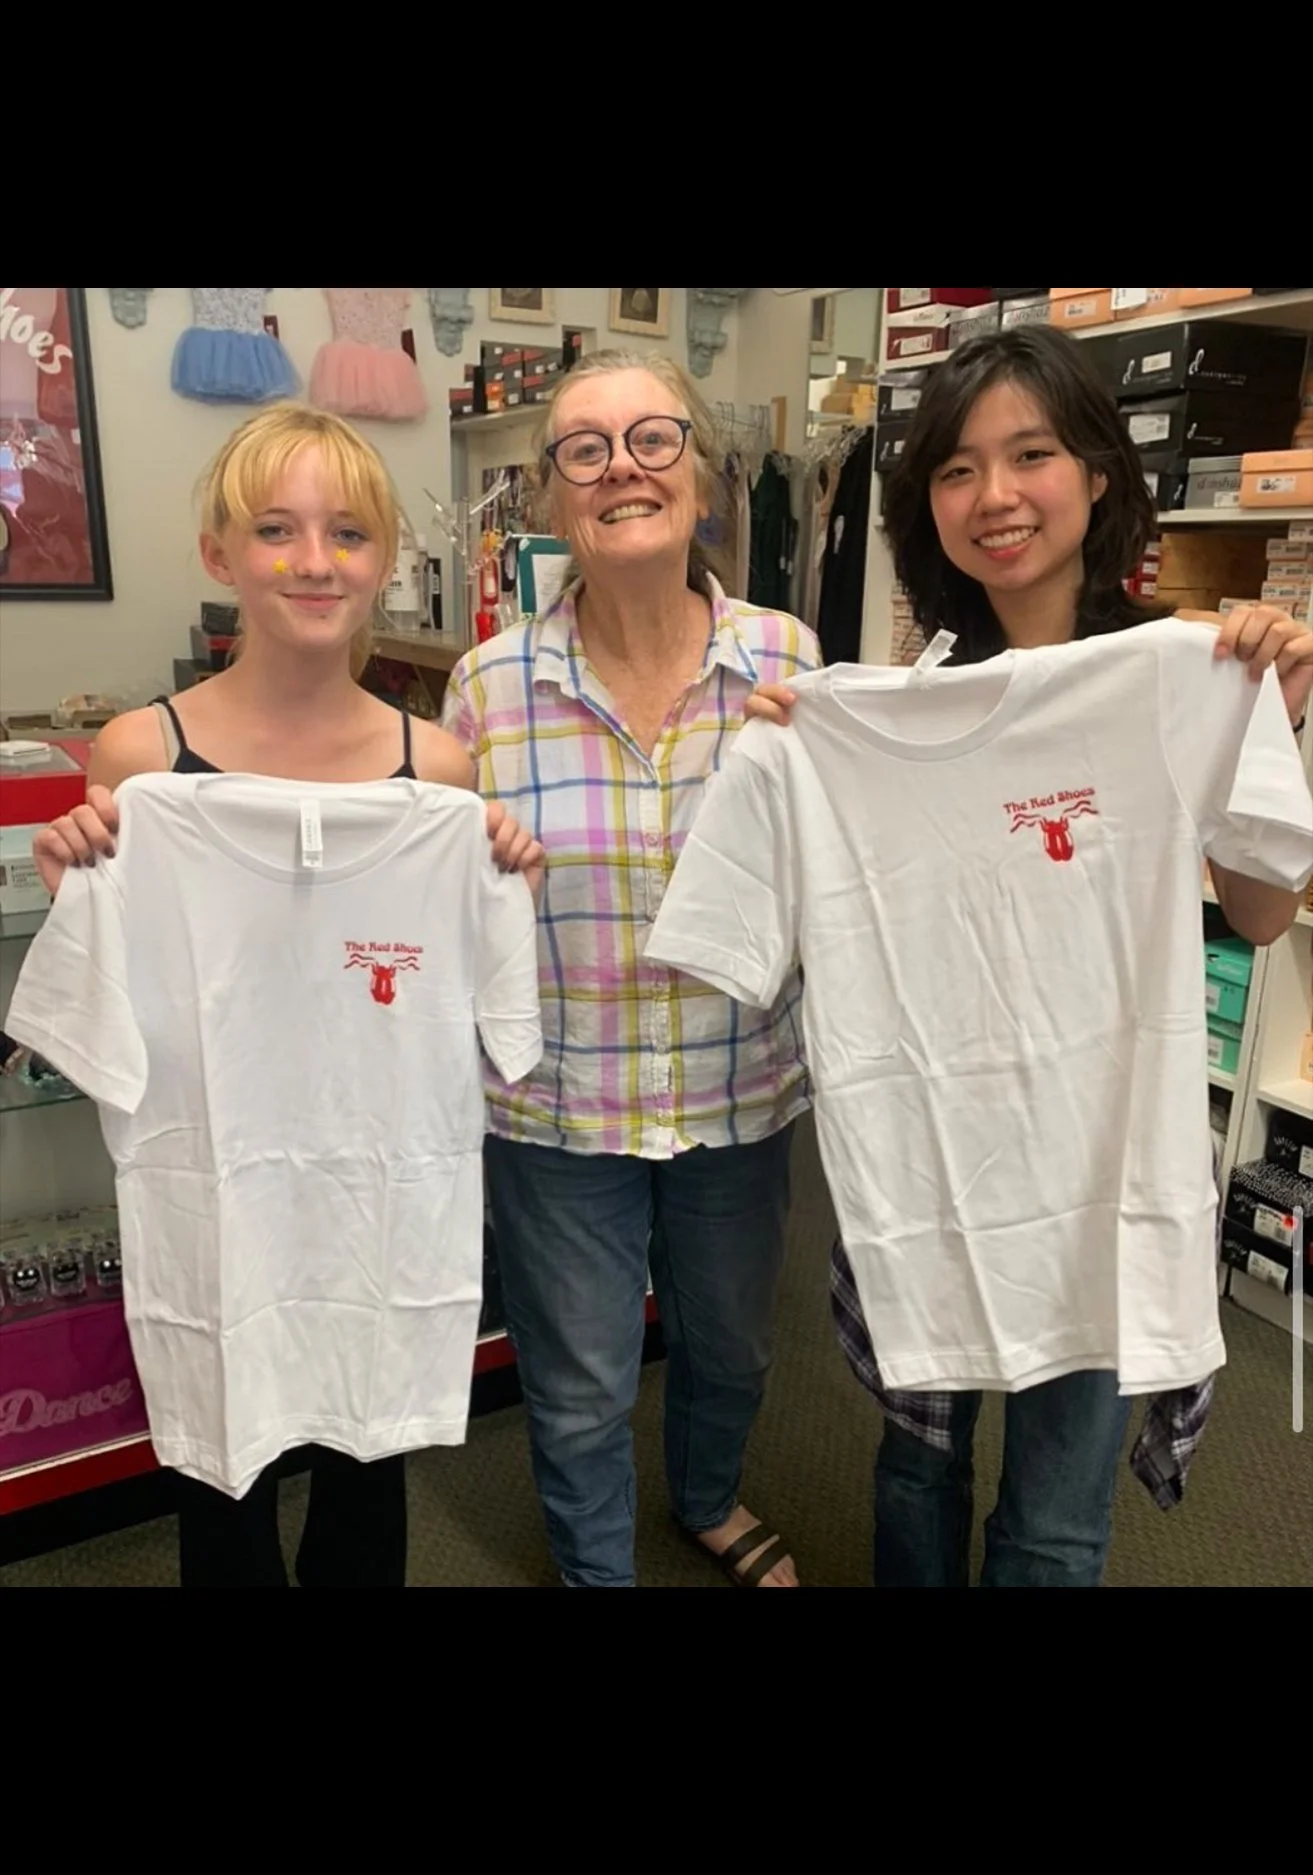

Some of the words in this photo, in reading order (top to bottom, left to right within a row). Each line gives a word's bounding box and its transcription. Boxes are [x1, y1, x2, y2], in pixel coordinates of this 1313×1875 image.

[1002, 801, 1028, 814] The
[1029, 794, 1055, 809] Red
[1057, 786, 1096, 802] Shoes
[344, 941, 366, 952] The
[369, 941, 391, 952] Red
[393, 942, 424, 954] Shoes
[0, 1378, 134, 1437] Dance
